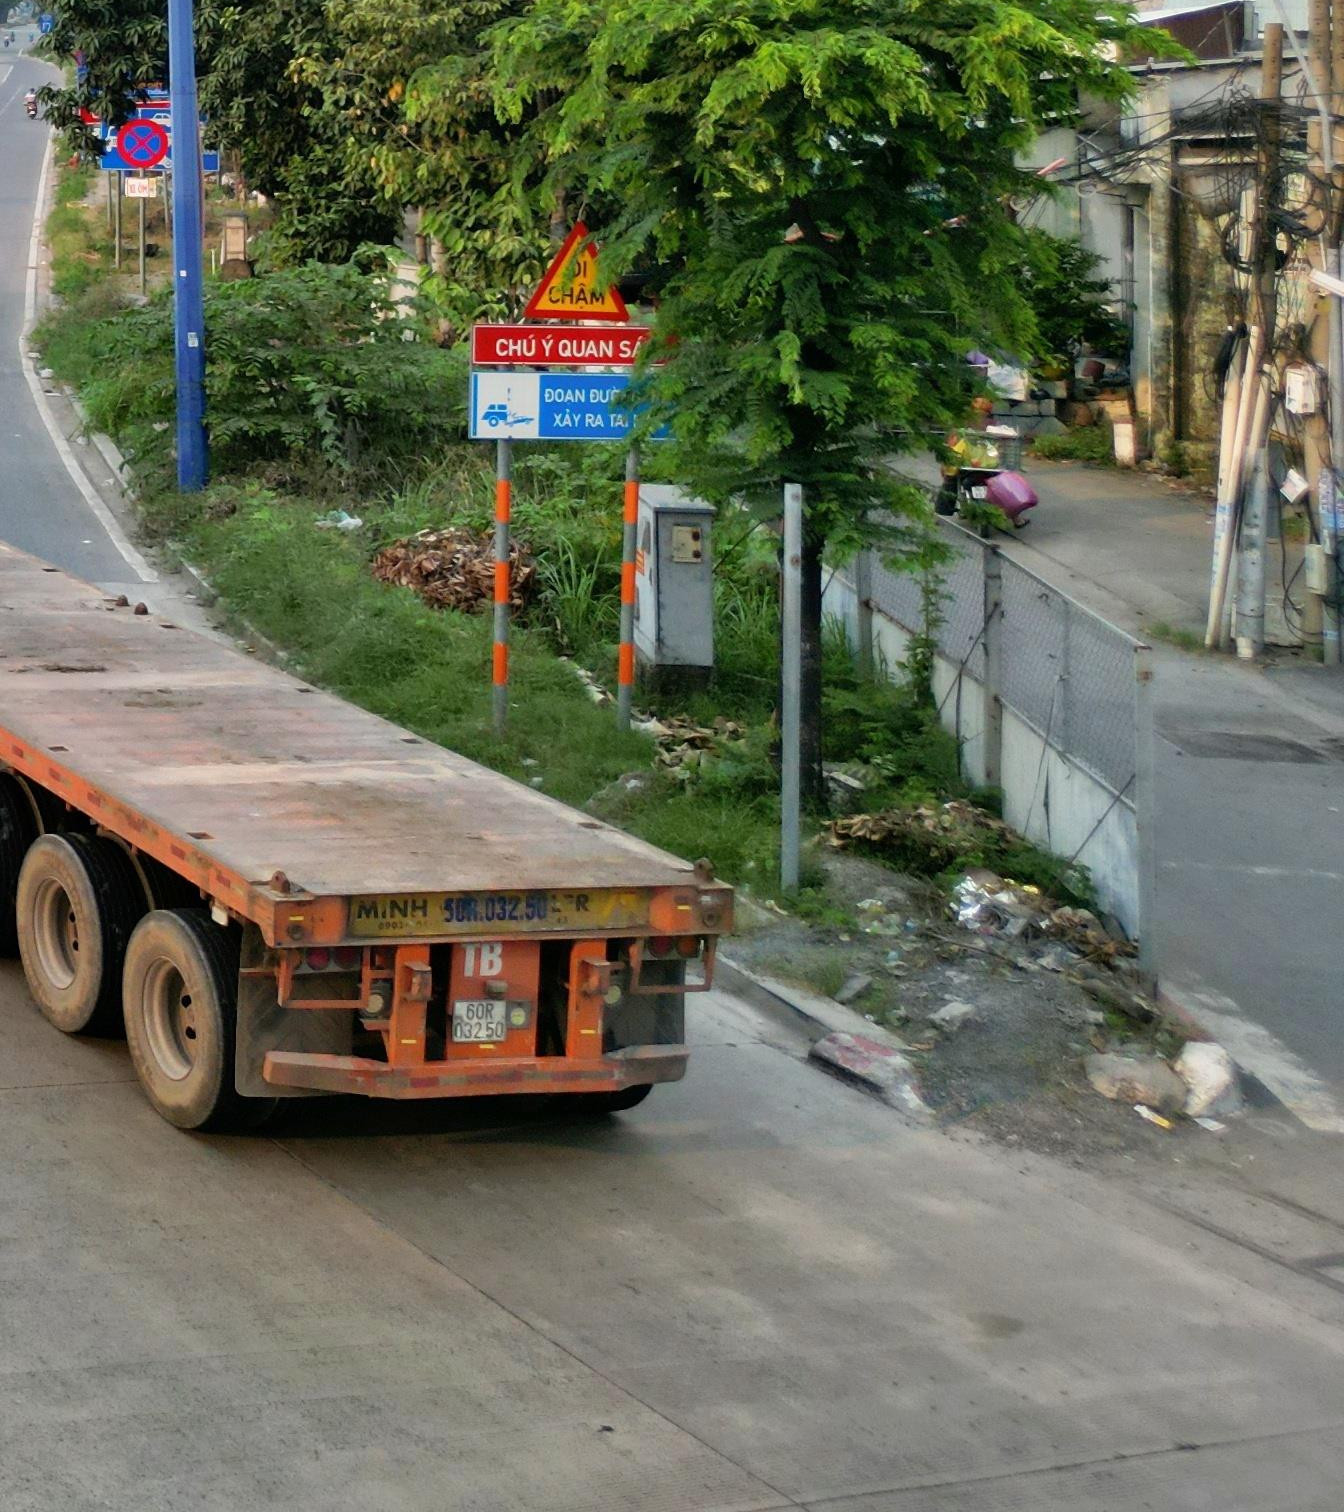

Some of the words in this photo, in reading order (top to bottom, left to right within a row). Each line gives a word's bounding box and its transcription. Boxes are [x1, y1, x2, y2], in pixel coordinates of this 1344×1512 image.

[495, 334, 536, 357] CHÚ
[542, 334, 554, 357] Ý
[558, 339, 613, 358] QUAN
[619, 335, 643, 358] SÁ
[553, 409, 581, 427] XẢY
[585, 414, 604, 427] RA
[466, 1003, 495, 1021] 60R
